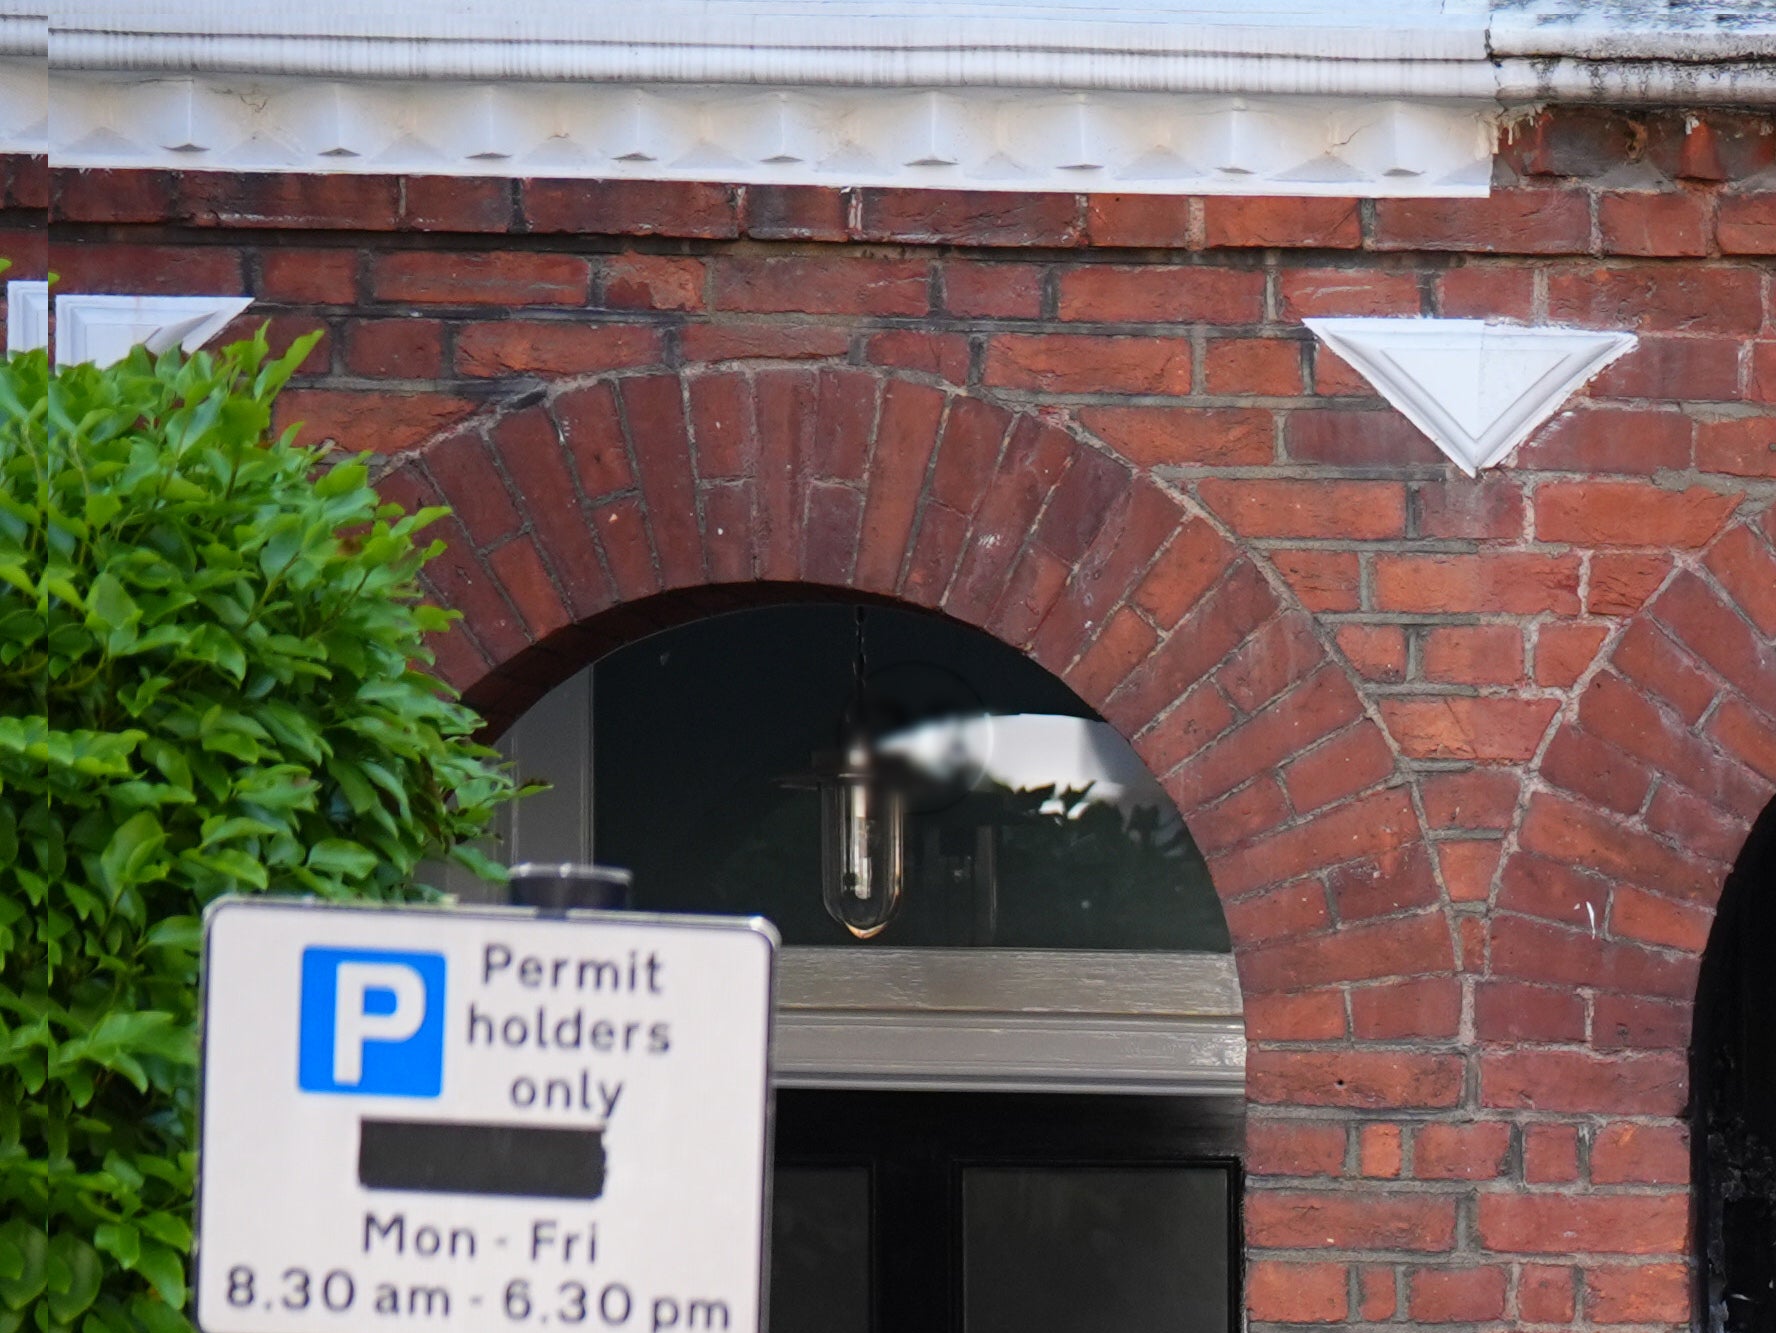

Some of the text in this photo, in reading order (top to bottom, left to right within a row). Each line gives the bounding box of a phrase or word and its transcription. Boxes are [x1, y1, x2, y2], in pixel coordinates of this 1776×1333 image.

[481, 942, 662, 995] Permit
[333, 961, 427, 1085] P
[466, 1002, 672, 1055] holders
[509, 1069, 624, 1119] only
[362, 1211, 477, 1259] Mon
[529, 1218, 598, 1264] Fri
[225, 1264, 357, 1314] 8.30
[373, 1282, 452, 1318] am
[502, 1278, 634, 1328] 6.30
